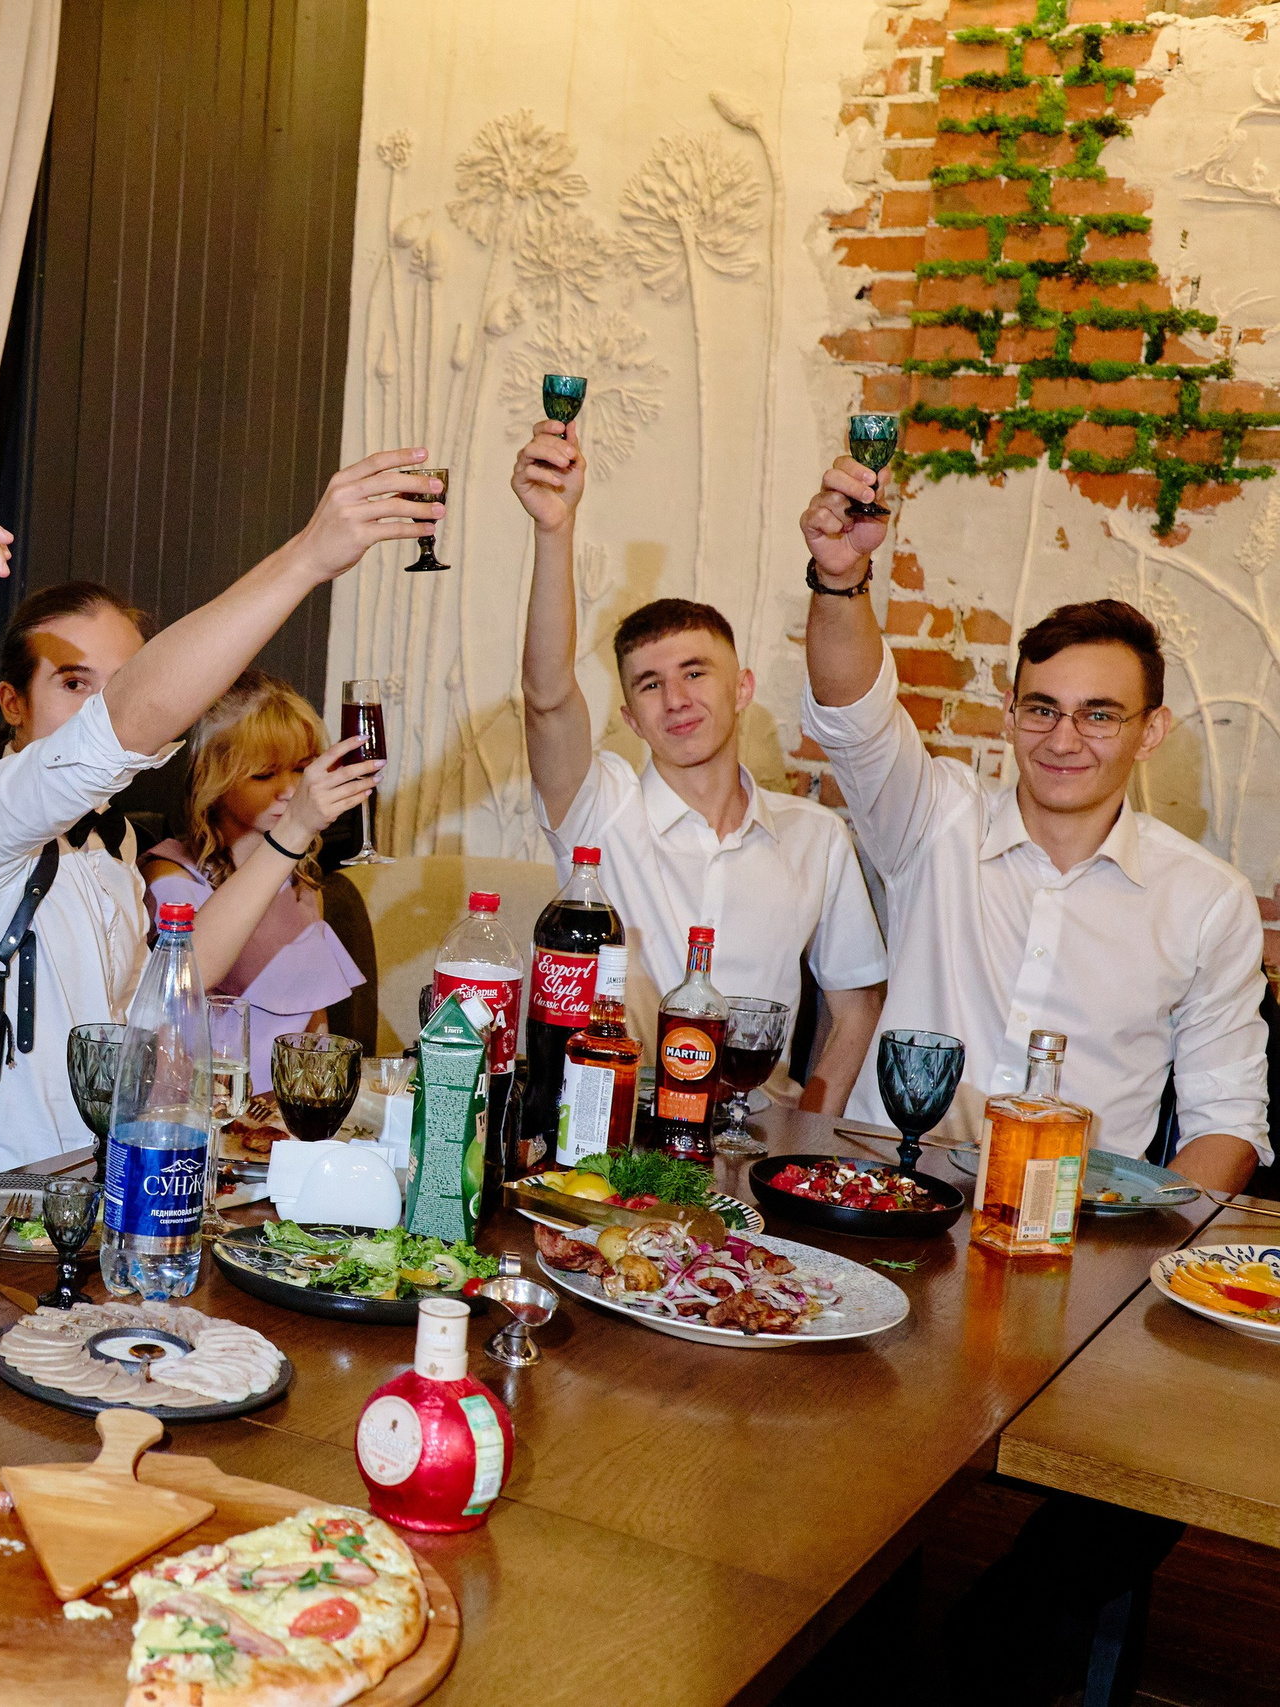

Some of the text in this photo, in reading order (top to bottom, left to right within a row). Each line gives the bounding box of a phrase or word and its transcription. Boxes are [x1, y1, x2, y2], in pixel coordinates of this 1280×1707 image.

[538, 955, 596, 984] Export
[541, 974, 582, 1000] Style
[534, 992, 590, 1013] Classic Cola
[666, 1046, 710, 1061] MARTINI
[669, 1091, 697, 1100] FIERO
[150, 1207, 192, 1218] ЛЕДНИКОВАЯ
